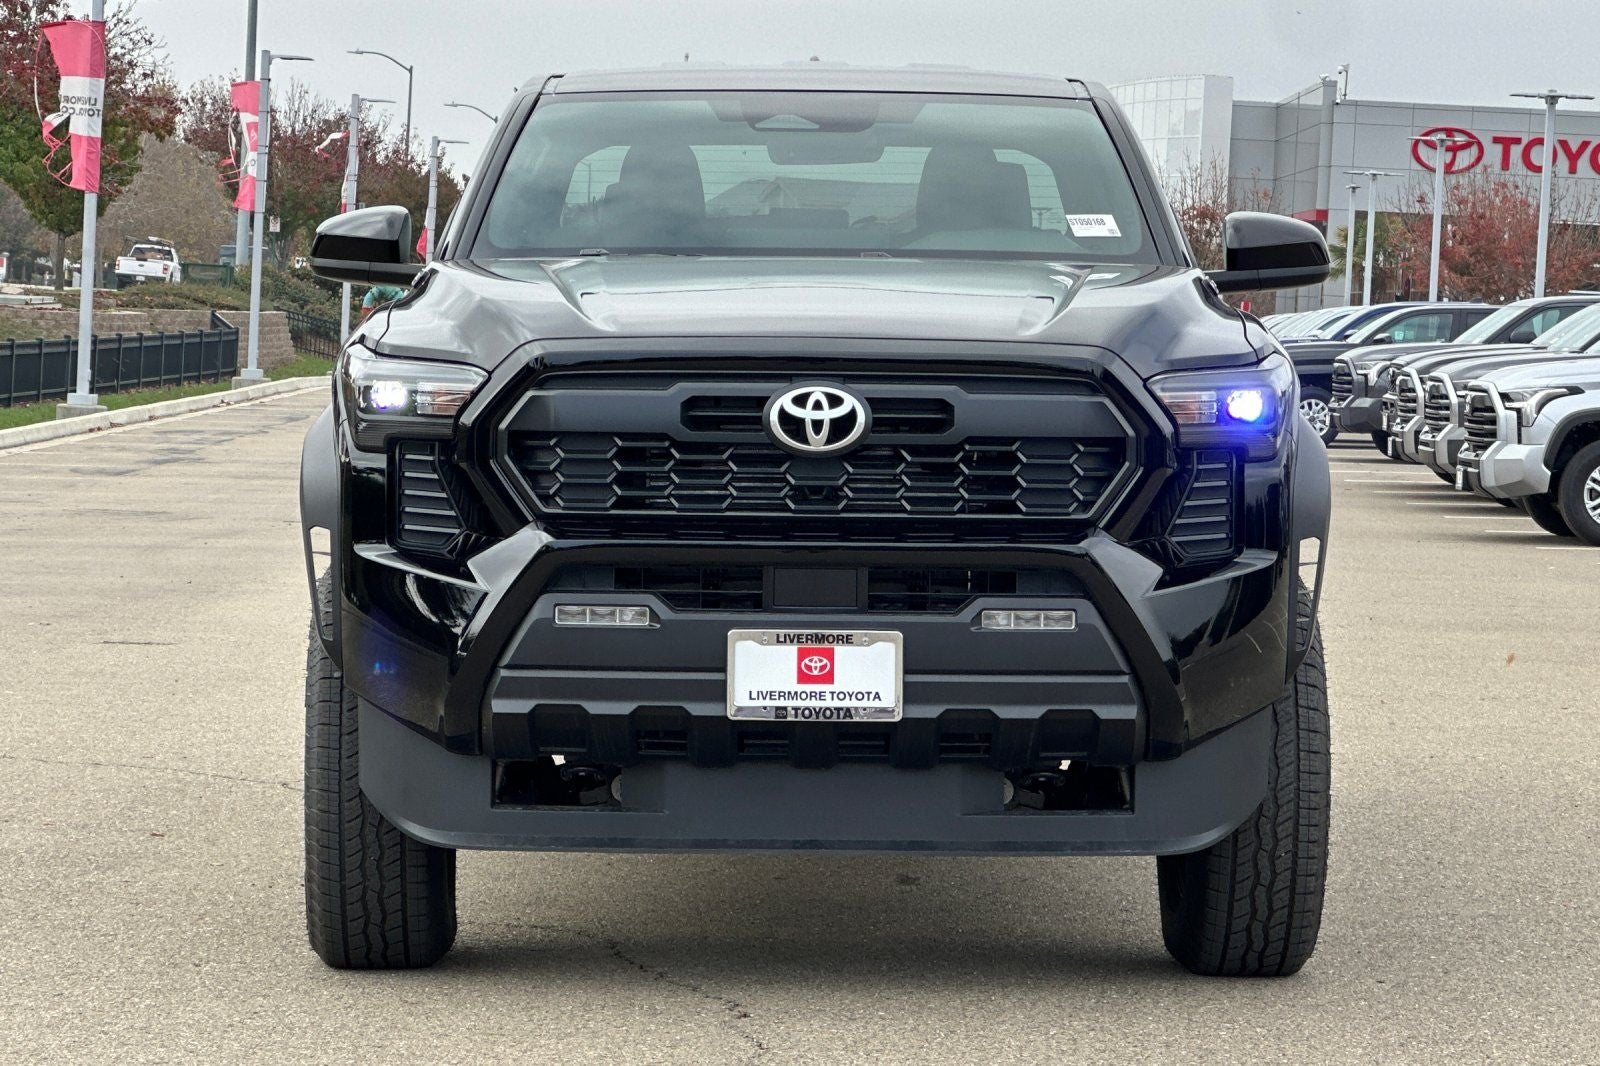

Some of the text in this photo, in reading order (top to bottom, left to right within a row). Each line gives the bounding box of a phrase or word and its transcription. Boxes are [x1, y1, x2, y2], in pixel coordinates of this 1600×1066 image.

[1492, 135, 1600, 176] TOY
[776, 633, 854, 645] LIVERMORE
[749, 690, 882, 702] LIVERMORE TOYOTA
[792, 707, 854, 720] TOYOTA
